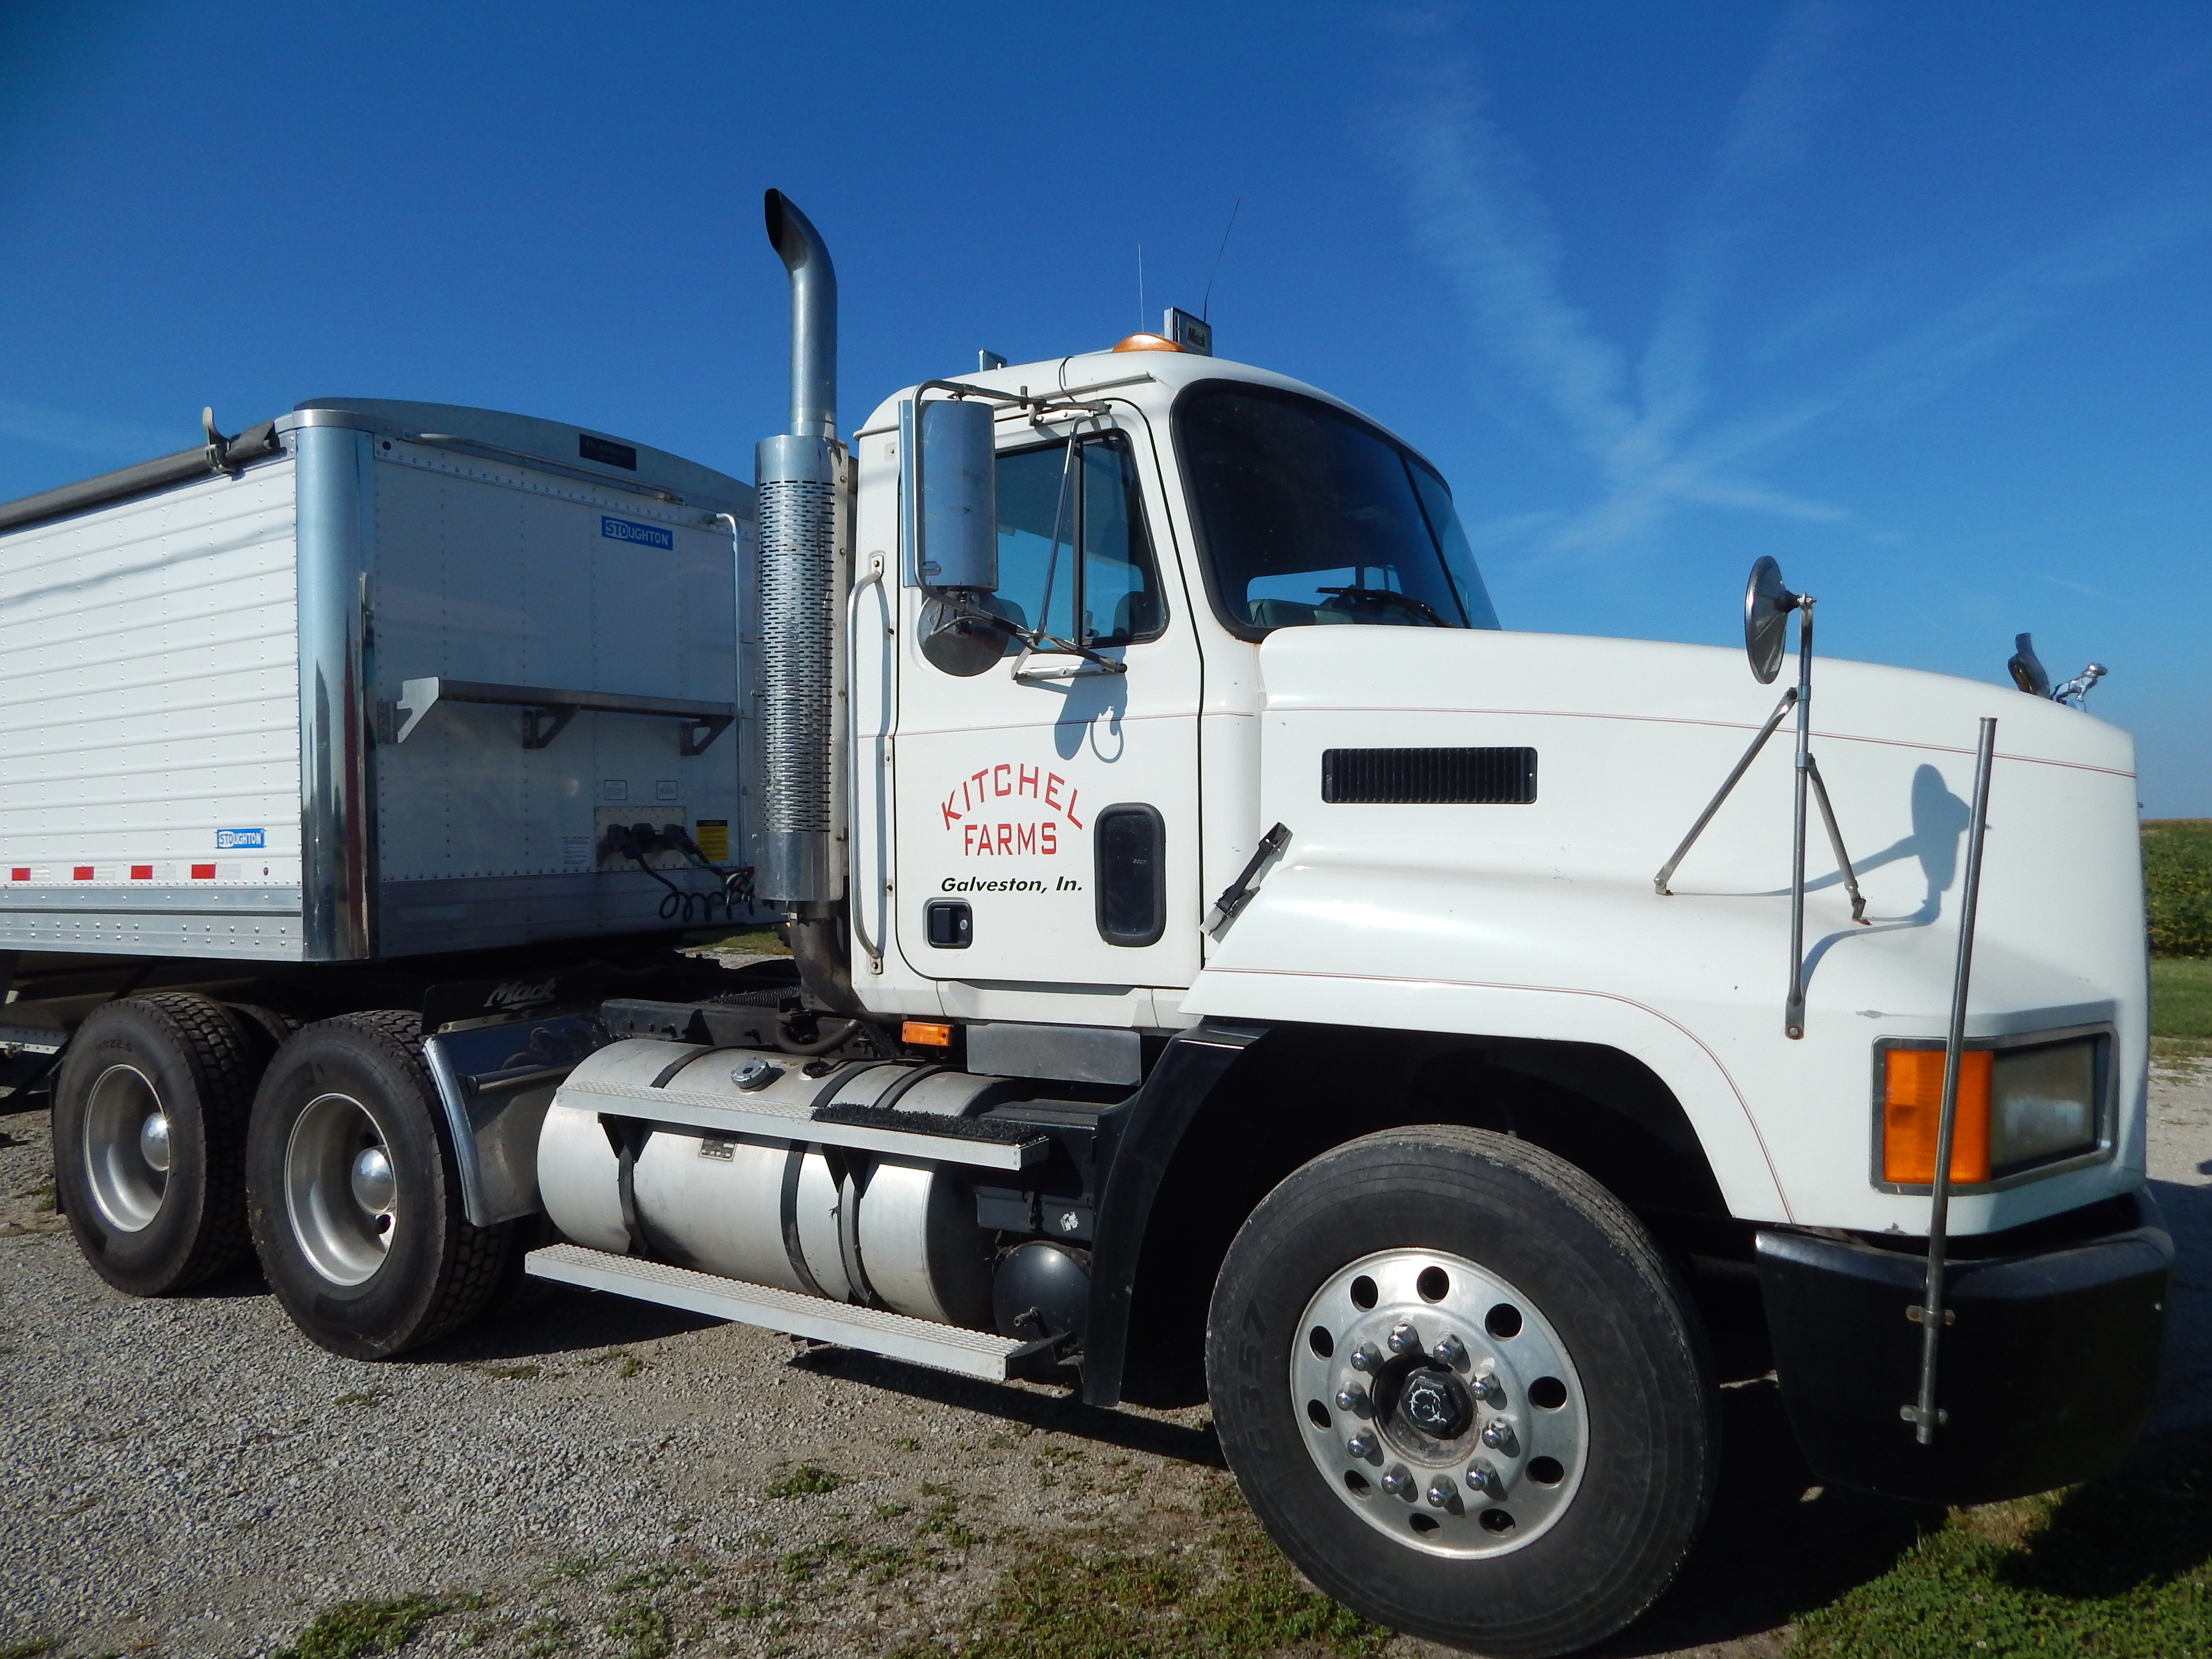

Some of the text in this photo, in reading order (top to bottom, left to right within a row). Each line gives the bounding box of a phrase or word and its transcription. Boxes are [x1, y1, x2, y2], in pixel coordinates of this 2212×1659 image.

[1187, 327, 1205, 348] Mack
[606, 522, 668, 545] STOUGHTON
[941, 763, 1082, 831] KITCHEL
[220, 832, 261, 844] STOUGHTON
[965, 822, 1056, 856] FARMS
[941, 876, 1082, 893] Galveston, In.
[483, 977, 555, 1010] Mack
